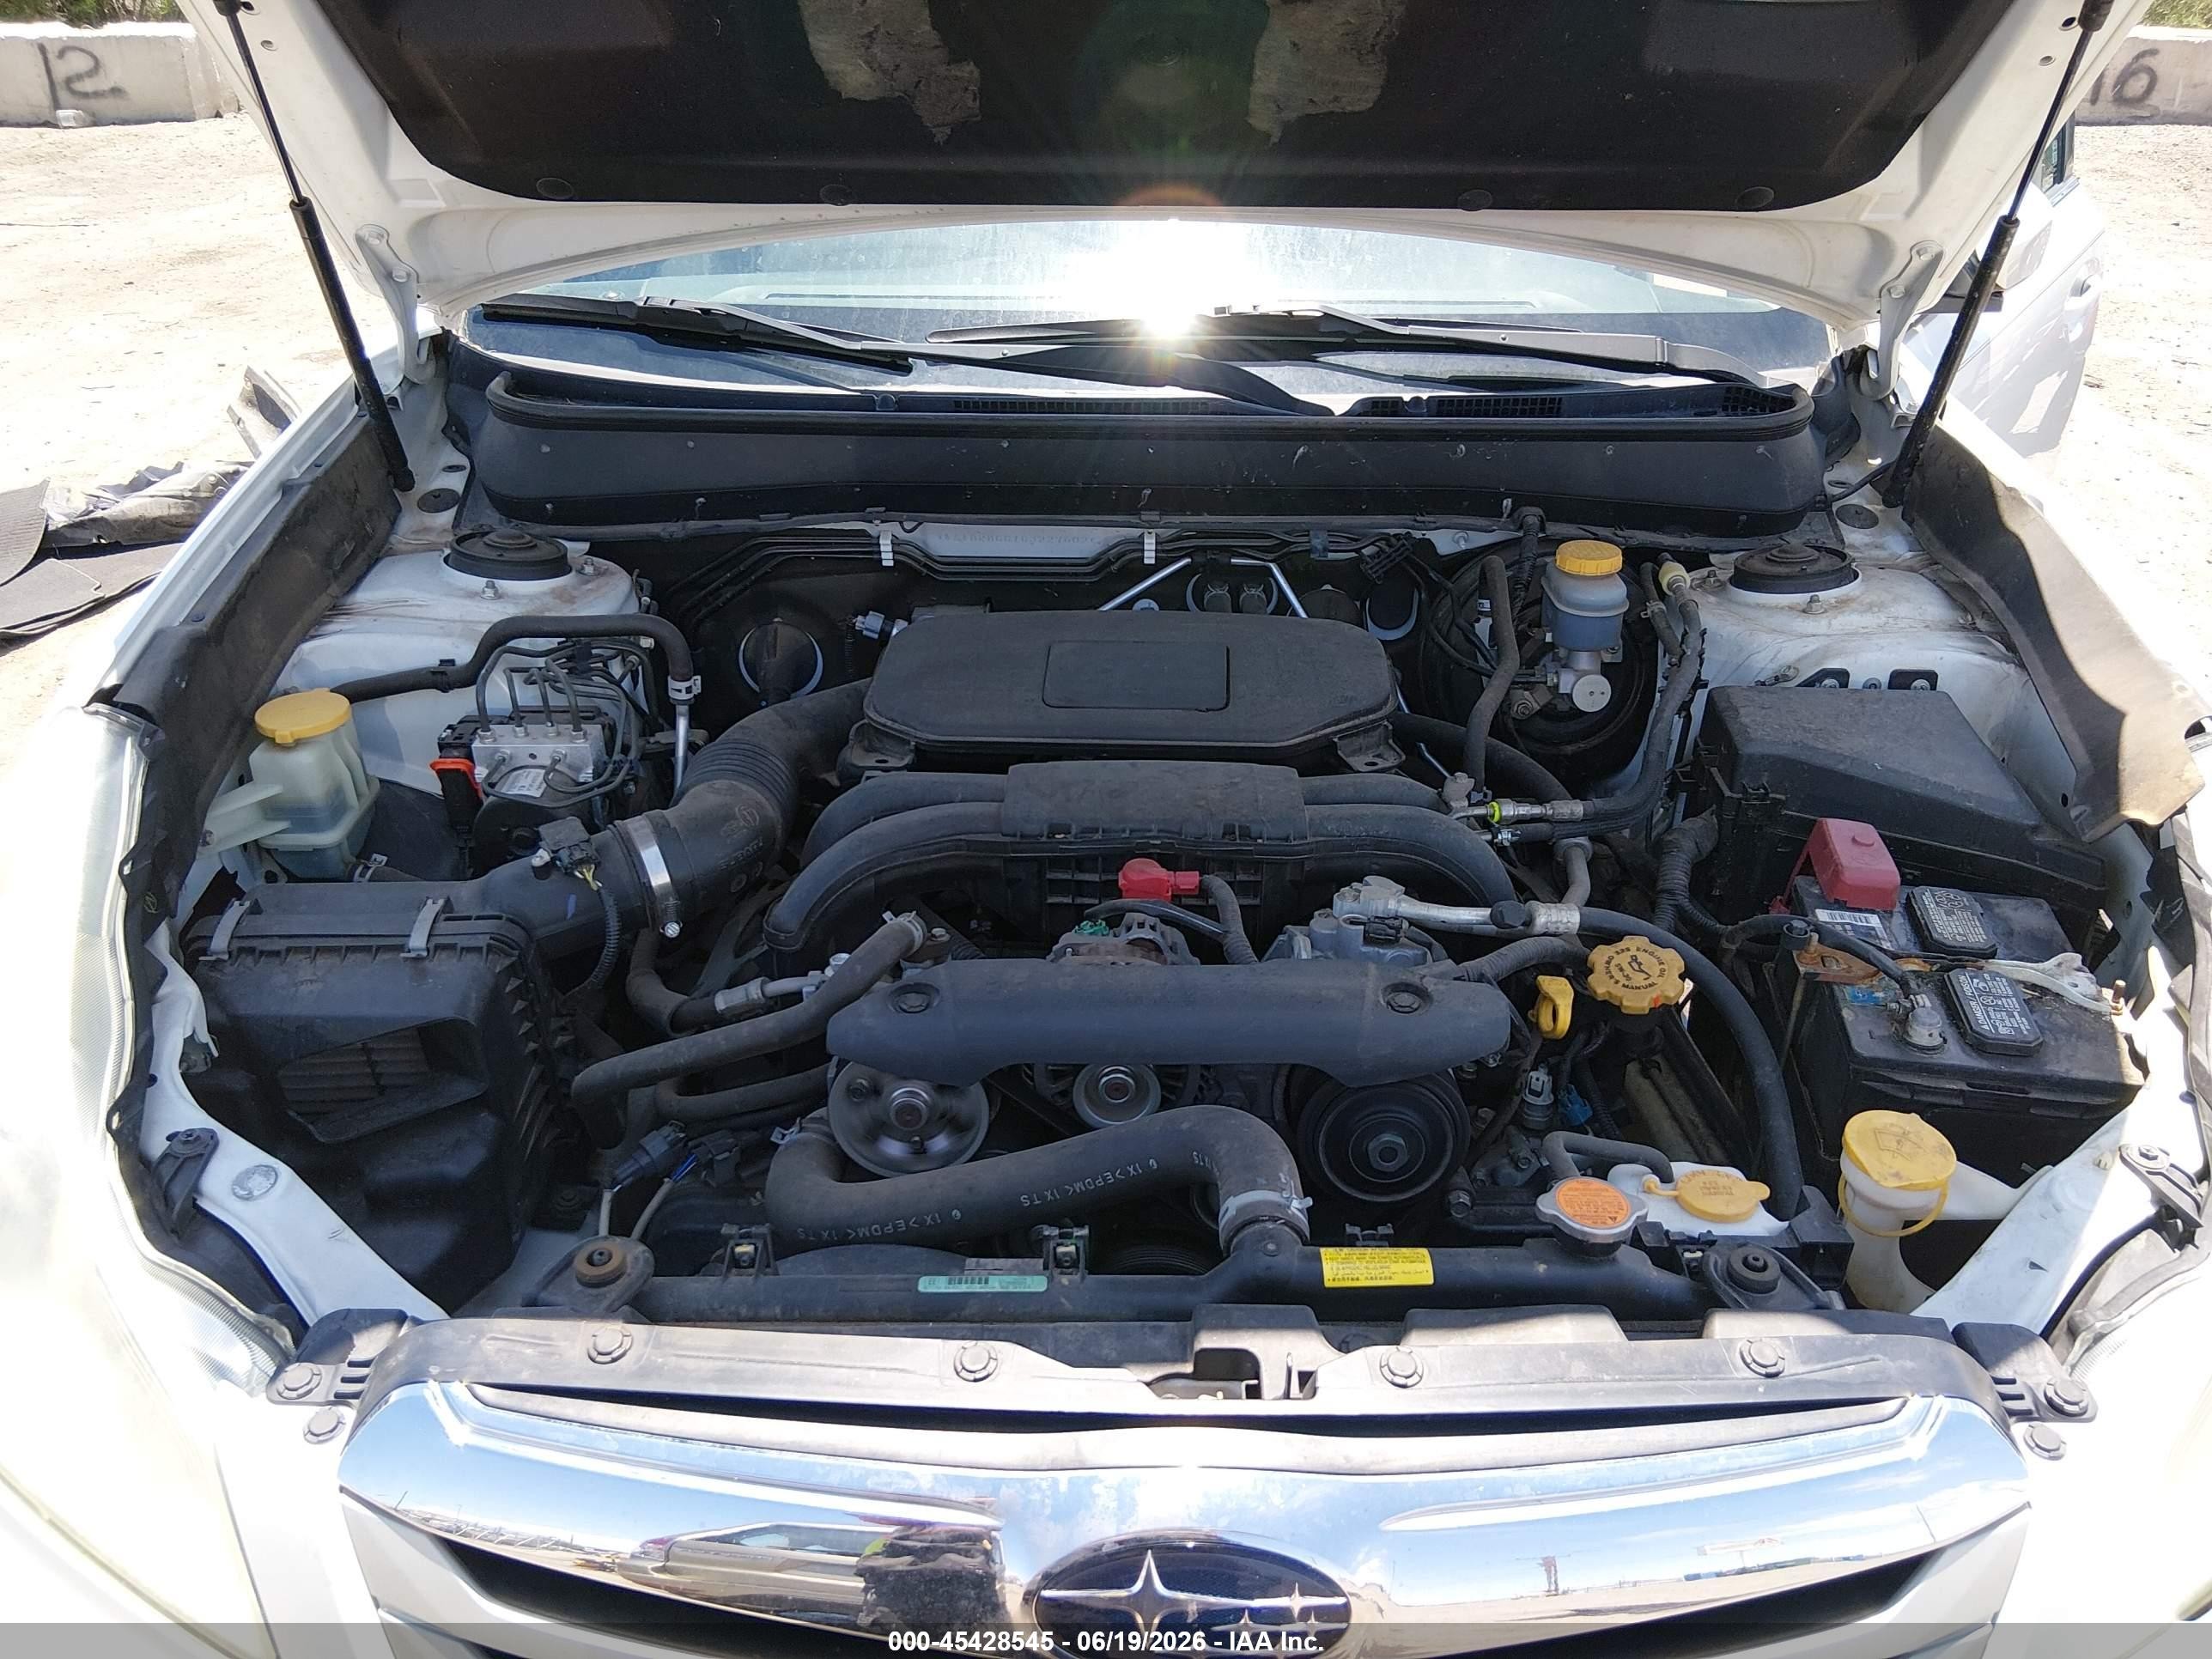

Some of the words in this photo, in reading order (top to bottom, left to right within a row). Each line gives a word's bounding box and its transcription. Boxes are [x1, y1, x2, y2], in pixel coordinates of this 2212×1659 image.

[37, 43, 127, 110] 12
[1615, 946, 1632, 956] SEE
[1635, 946, 1666, 966] ENGINE
[1656, 968, 1668, 979] OIL
[1621, 981, 1659, 990] MANUAL
[1958, 975, 1974, 996] POISON
[1969, 1000, 1988, 1025] DANGER
